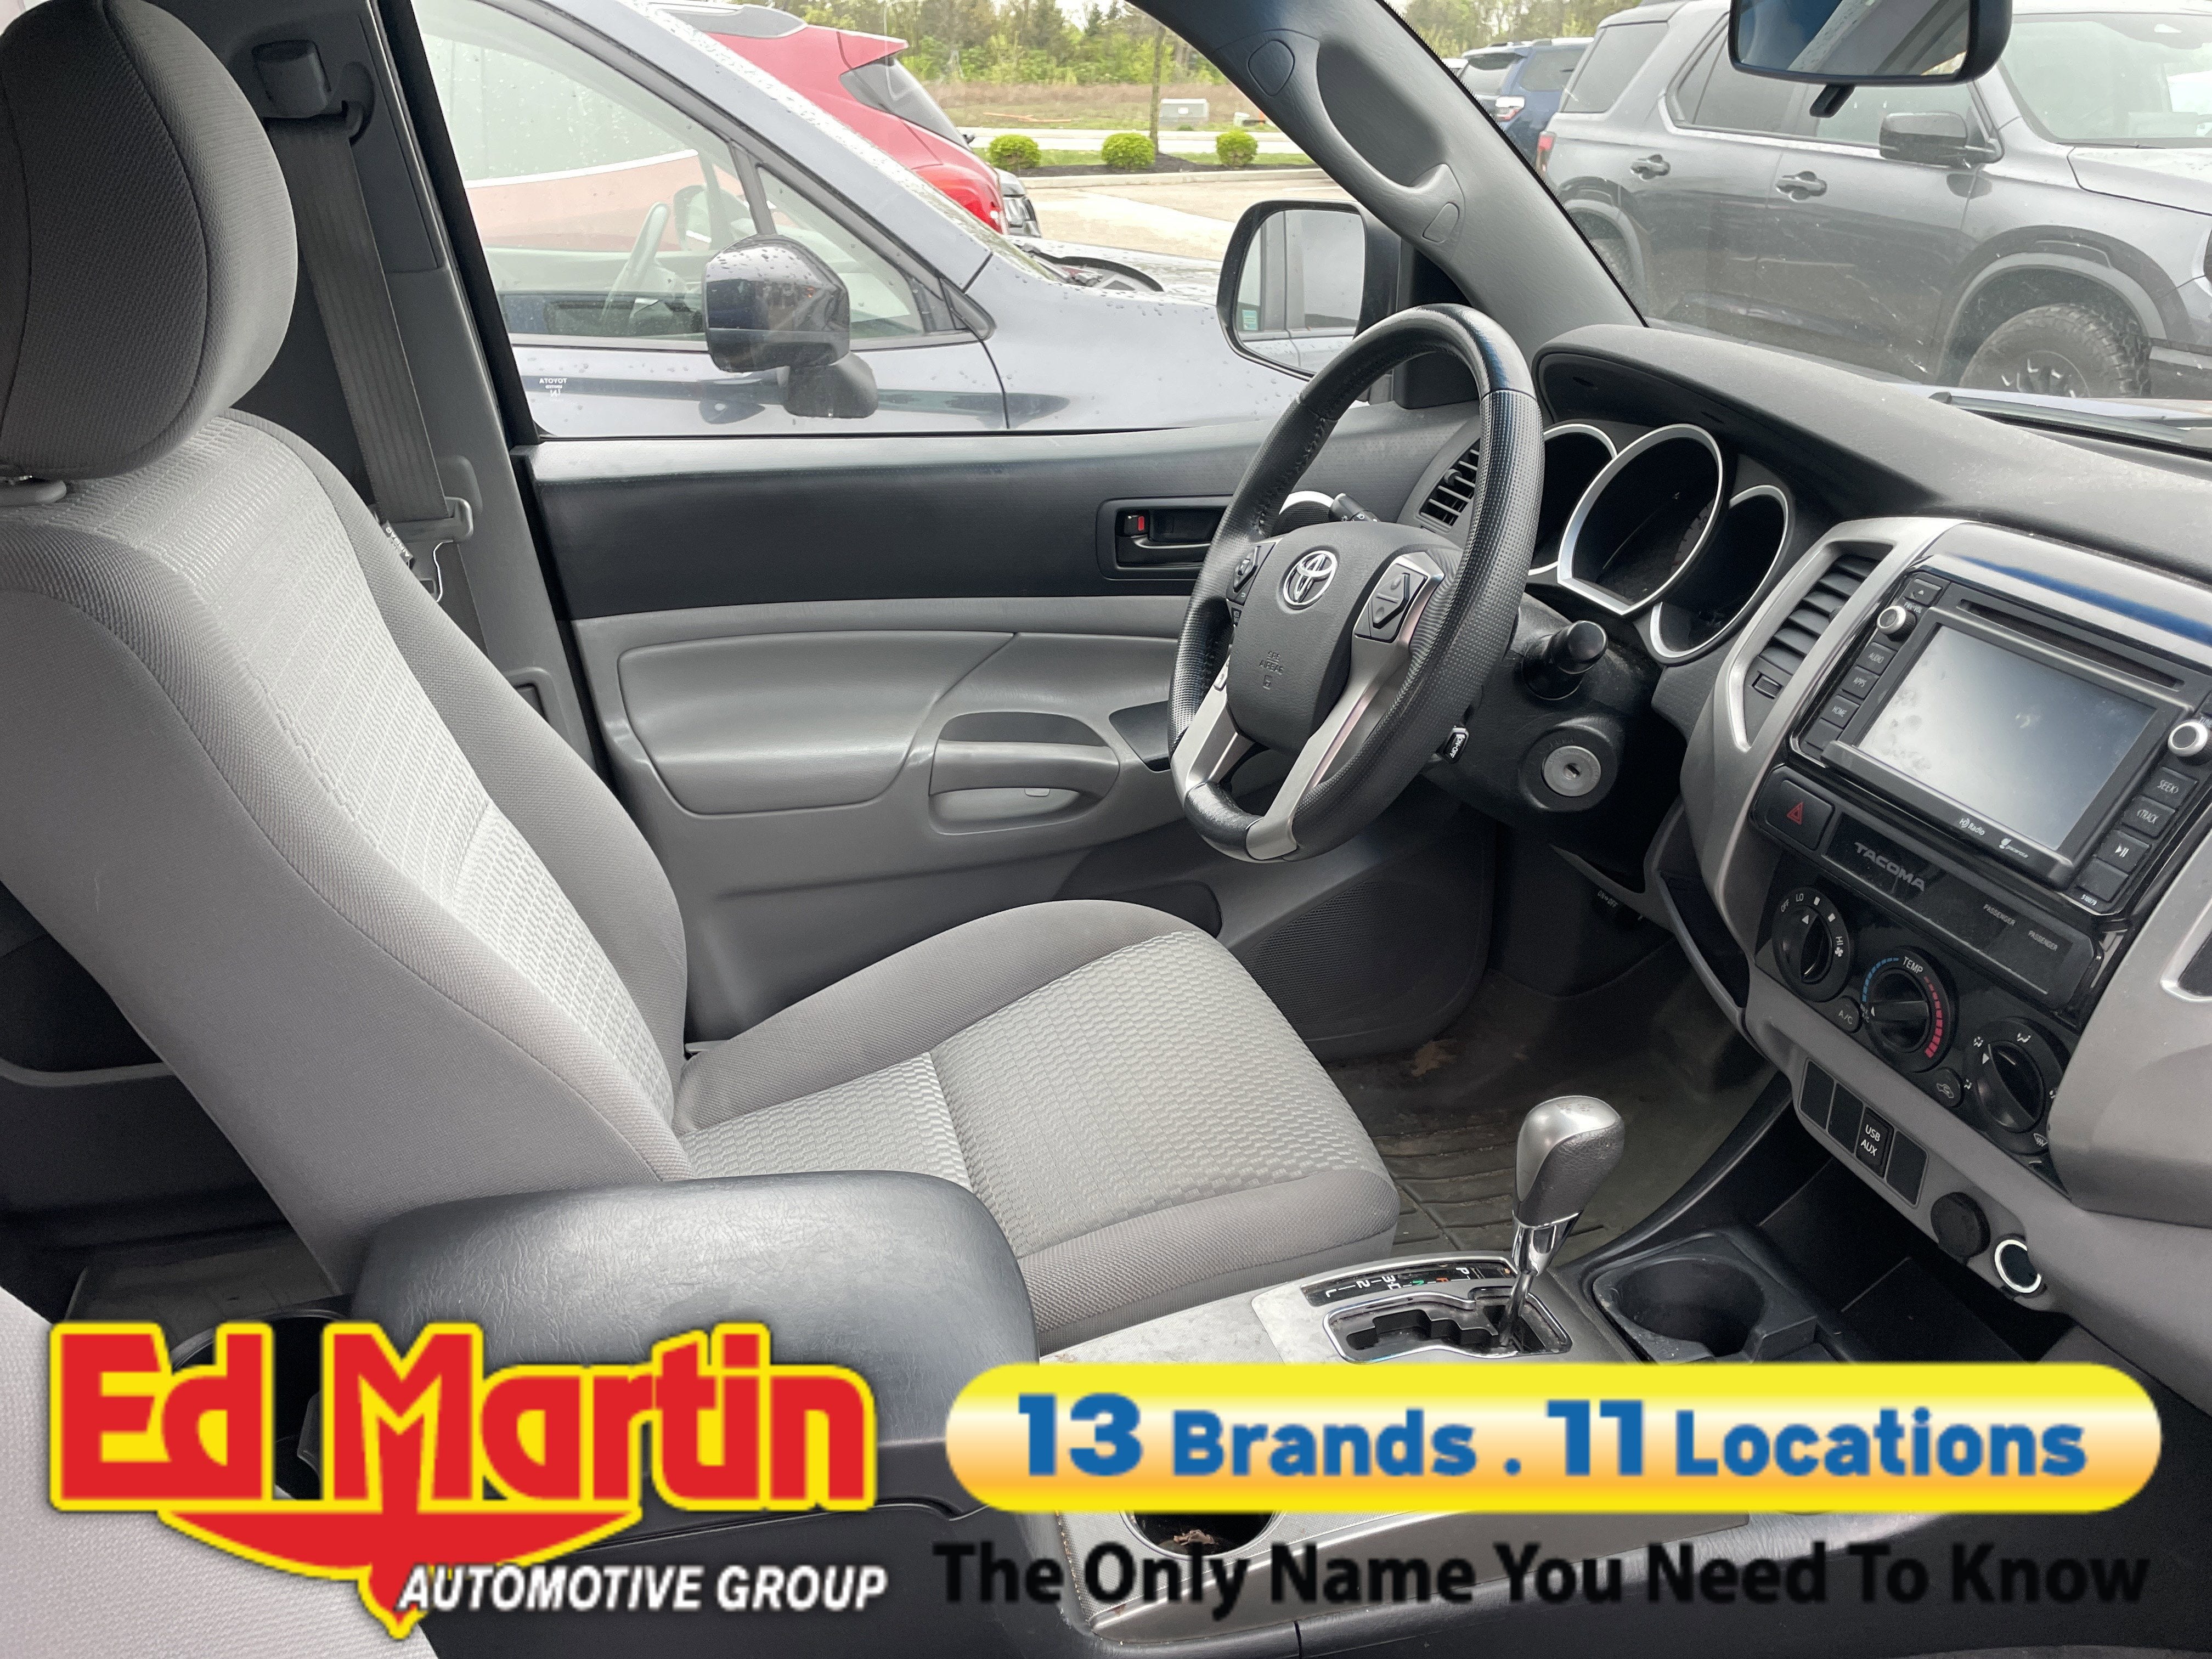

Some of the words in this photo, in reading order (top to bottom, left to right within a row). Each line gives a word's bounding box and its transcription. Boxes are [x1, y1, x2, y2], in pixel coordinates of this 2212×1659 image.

[1854, 842, 1925, 892] TACOMA
[1780, 899, 1790, 912] OFF
[1796, 893, 1804, 902] LO
[1983, 904, 2016, 926] PASSENGER
[1836, 936, 1844, 946] HI
[2028, 930, 2058, 952] PASSENGER
[1903, 956, 1923, 974] TEMP
[1838, 1010, 1853, 1025] A/C
[1865, 1124, 1881, 1142] USB
[1860, 1139, 1878, 1156] AUX
[1356, 1279, 1371, 1289] 2
